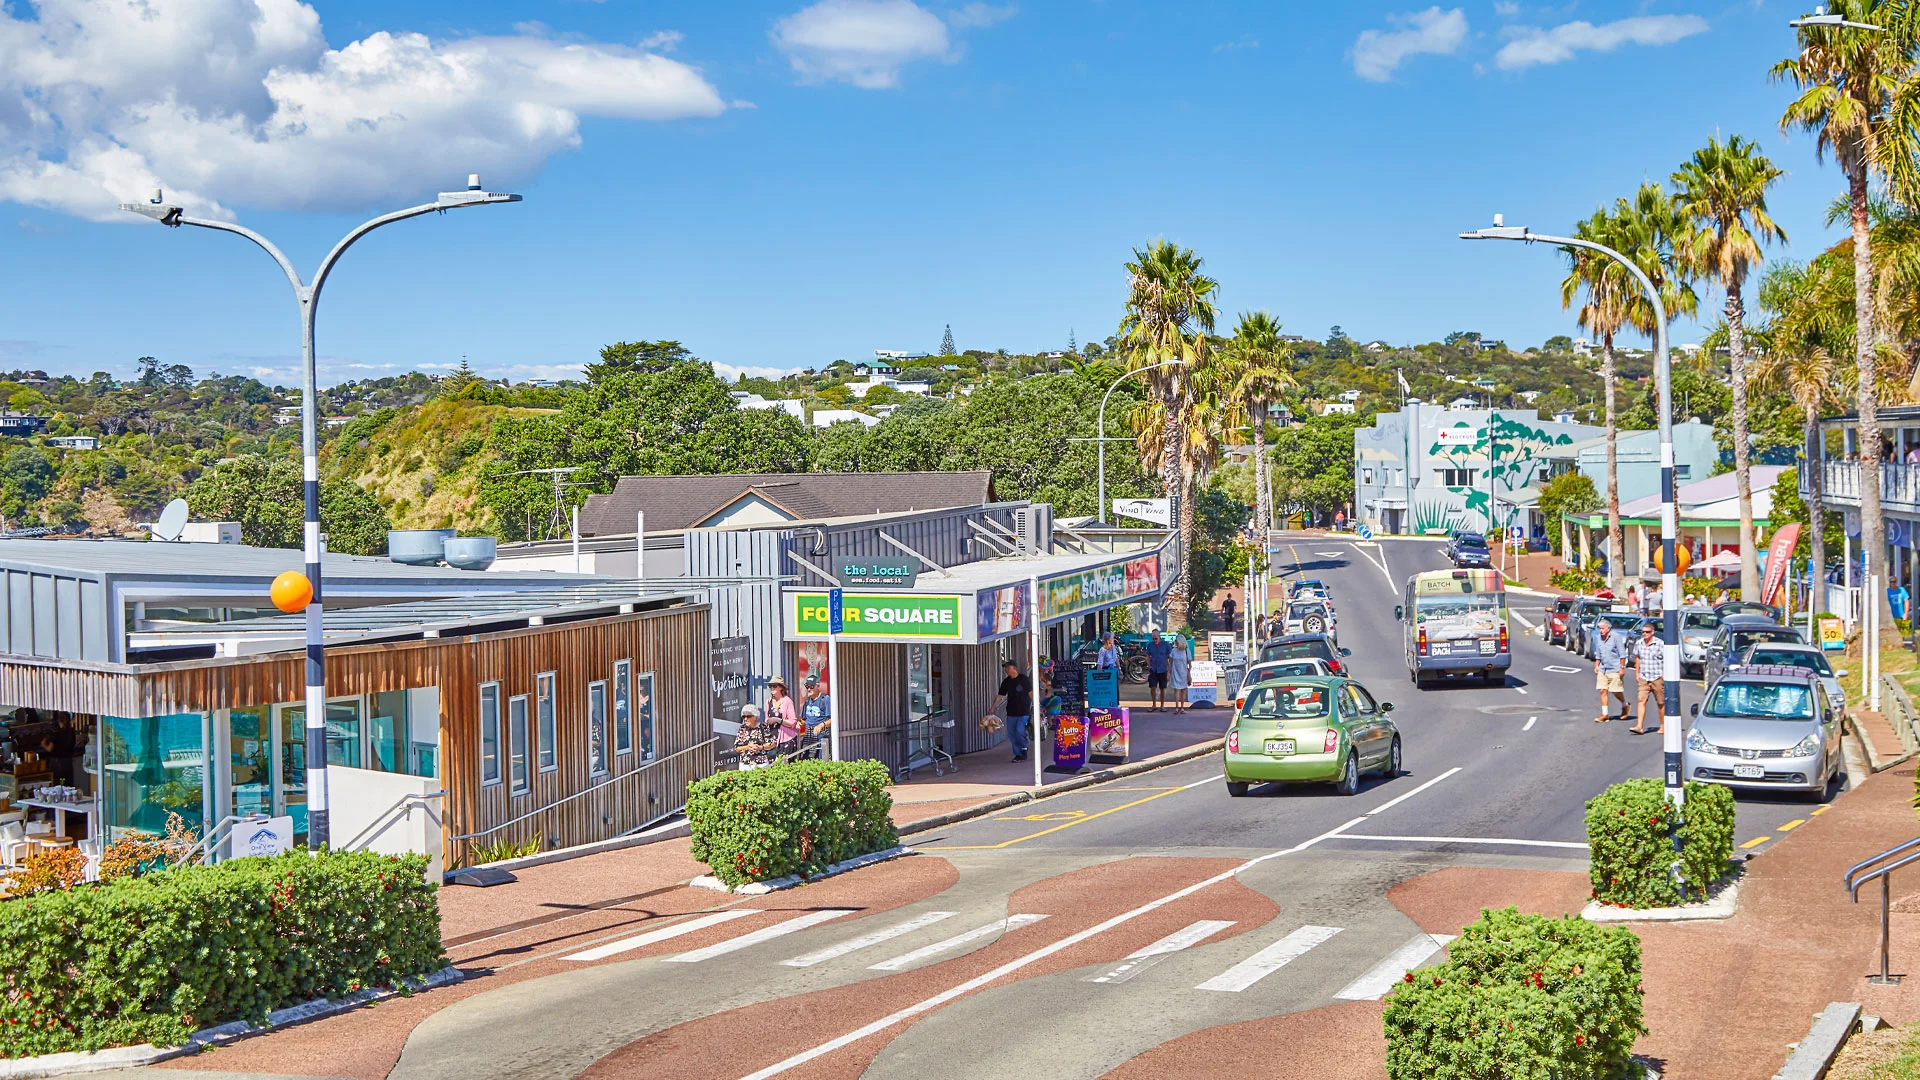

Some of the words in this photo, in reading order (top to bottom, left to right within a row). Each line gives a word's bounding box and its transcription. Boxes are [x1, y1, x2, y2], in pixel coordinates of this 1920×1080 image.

[844, 565, 867, 576] the
[872, 565, 910, 577] local
[1082, 574, 1123, 599] SQUARE
[802, 607, 861, 622] FOR
[864, 608, 953, 624] SQUARE
[1095, 714, 1111, 722] PAVED
[1104, 719, 1121, 729] GOLD
